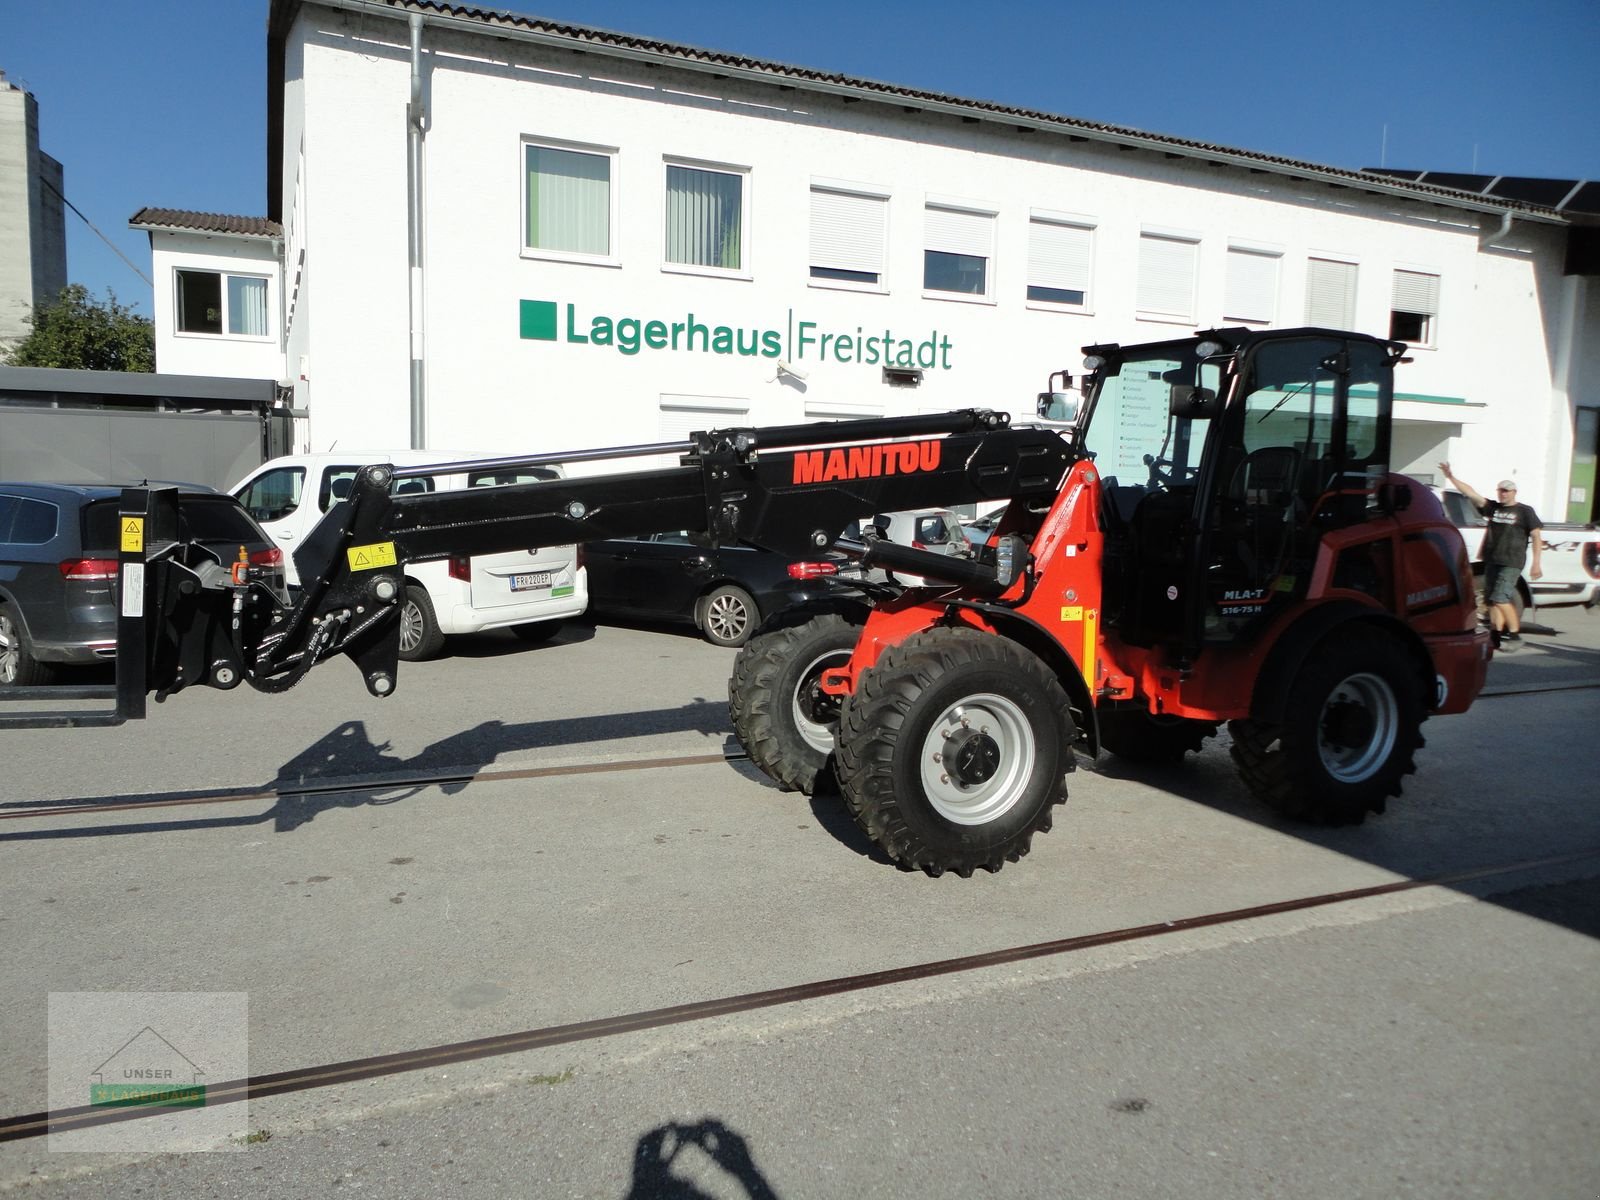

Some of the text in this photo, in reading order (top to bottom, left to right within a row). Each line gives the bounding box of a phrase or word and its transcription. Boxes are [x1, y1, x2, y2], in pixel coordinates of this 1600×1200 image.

[567, 303, 953, 370] Lagerhaus Freistadt
[793, 440, 941, 484] MANITOU
[1224, 589, 1264, 600] MLA-T
